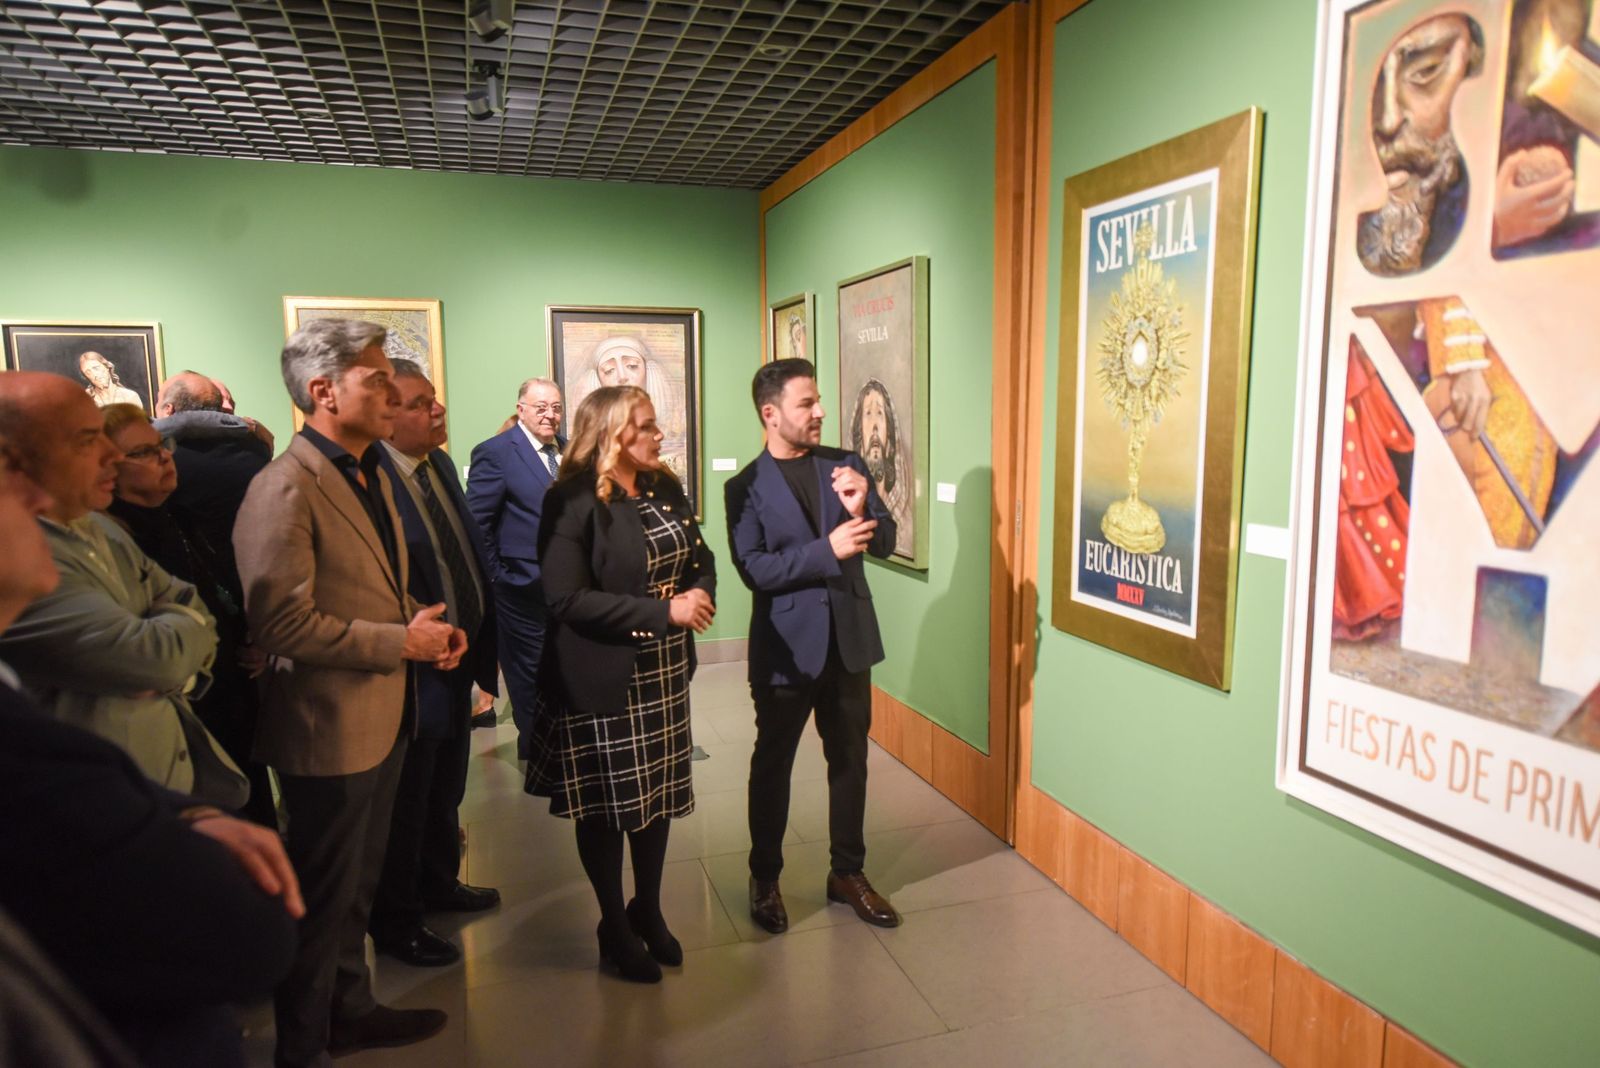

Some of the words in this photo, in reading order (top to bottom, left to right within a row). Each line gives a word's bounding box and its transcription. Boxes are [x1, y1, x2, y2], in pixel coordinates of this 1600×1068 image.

[1096, 194, 1198, 273] SEVLLA
[857, 326, 888, 344] SEVILLA
[1325, 699, 1437, 783] FIESTAS
[1449, 739, 1495, 804] DE
